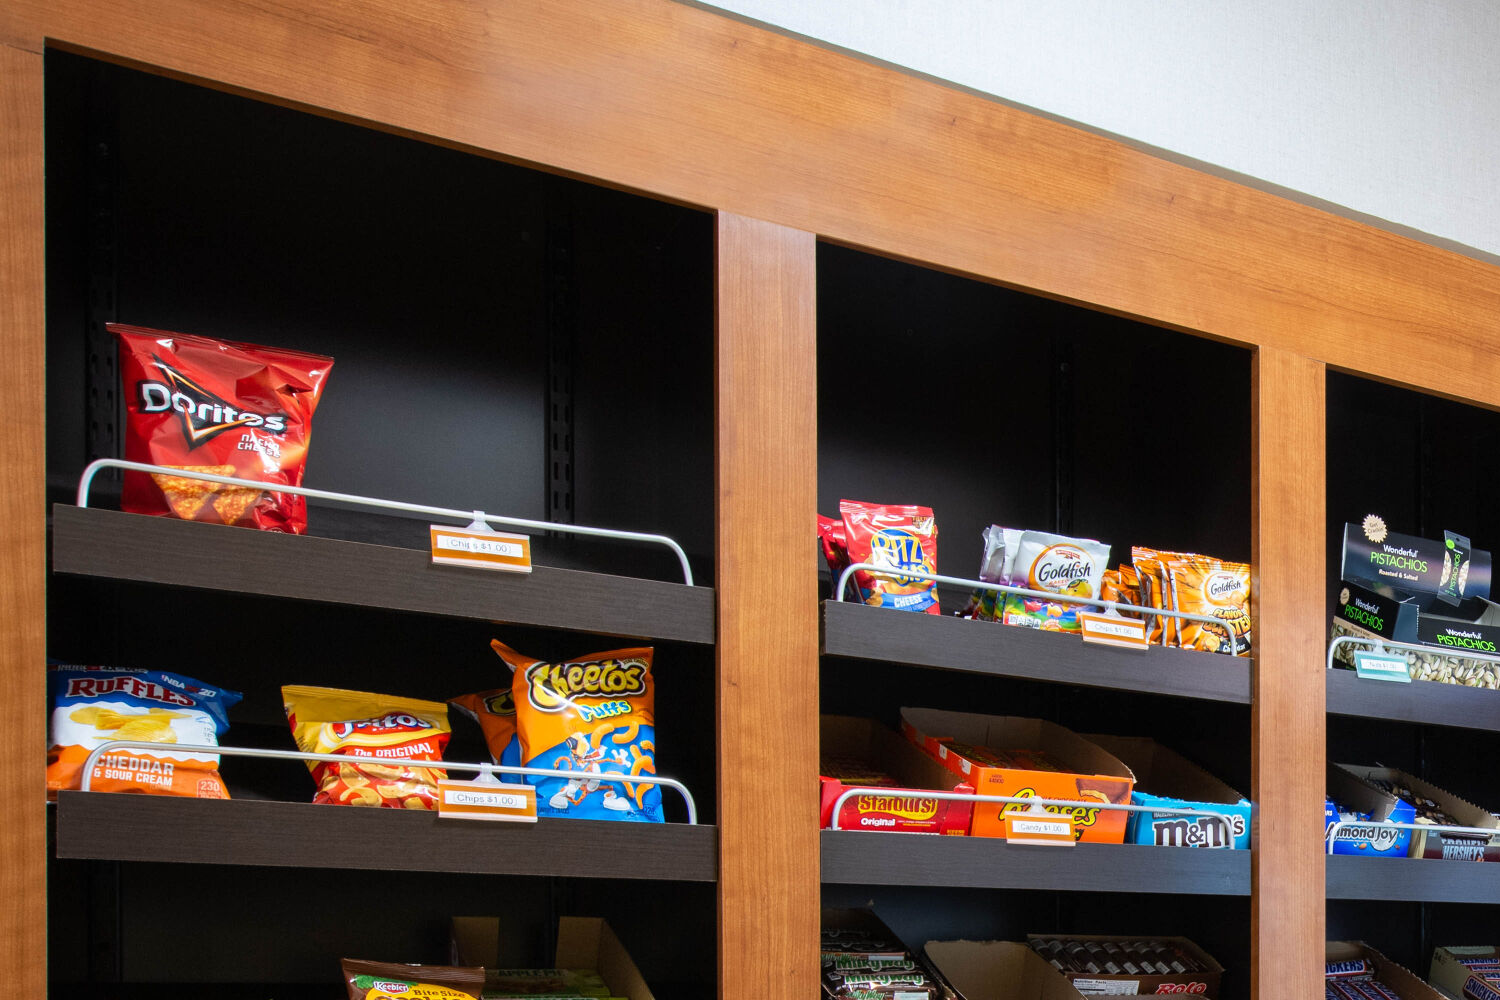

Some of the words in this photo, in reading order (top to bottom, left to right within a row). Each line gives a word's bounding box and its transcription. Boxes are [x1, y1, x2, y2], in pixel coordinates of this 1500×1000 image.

[141, 383, 285, 431] Doritos
[1383, 544, 1418, 557] Wonderful
[1370, 551, 1428, 573] PISTACHIOS
[1038, 561, 1091, 582] Goldfish
[1210, 579, 1241, 595] Goldfish
[1355, 598, 1380, 614] Wonderful
[1344, 604, 1384, 631] PISTACHIOS
[1446, 628, 1482, 640] Wonderful
[1436, 634, 1497, 652] PISTACHIOS
[66, 676, 196, 707] RUFFLES
[530, 660, 642, 707] Cheetos
[580, 701, 632, 721] Puffs
[375, 743, 434, 758] ORIGINAL
[96, 755, 175, 776] CHEDDAR
[105, 769, 133, 781] SOUR
[136, 773, 174, 786] CREAM
[457, 793, 485, 804] Chips
[487, 796, 514, 806] $1.00
[860, 818, 896, 827] Original
[1020, 823, 1042, 833] Candy
[1043, 824, 1063, 832] $1.00
[1376, 826, 1398, 844] Joy
[1442, 846, 1485, 861] HERSHEY'S
[374, 981, 409, 993] Keebler
[1155, 982, 1207, 995] Rolo
